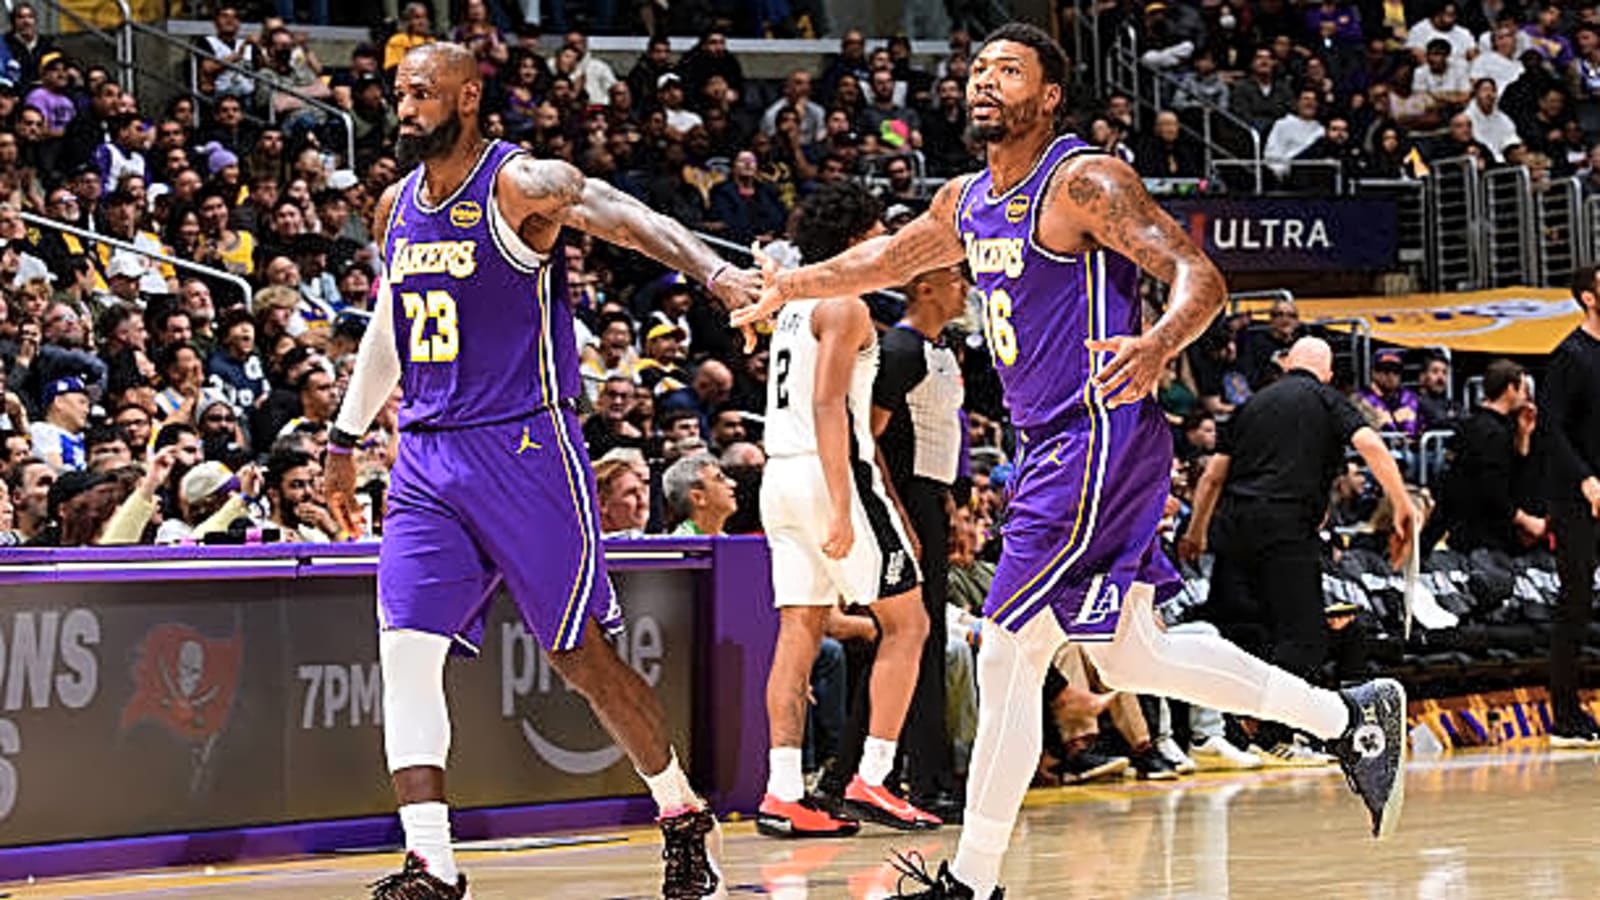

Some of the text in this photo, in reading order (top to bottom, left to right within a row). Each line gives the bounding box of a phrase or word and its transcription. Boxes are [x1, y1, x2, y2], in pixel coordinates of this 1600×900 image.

[390, 238, 477, 284] LAKERS
[1213, 218, 1330, 249] ULTRA
[401, 290, 459, 362] 23
[776, 348, 791, 409] 2
[0, 608, 100, 710] NS
[299, 664, 380, 729] 7PM
